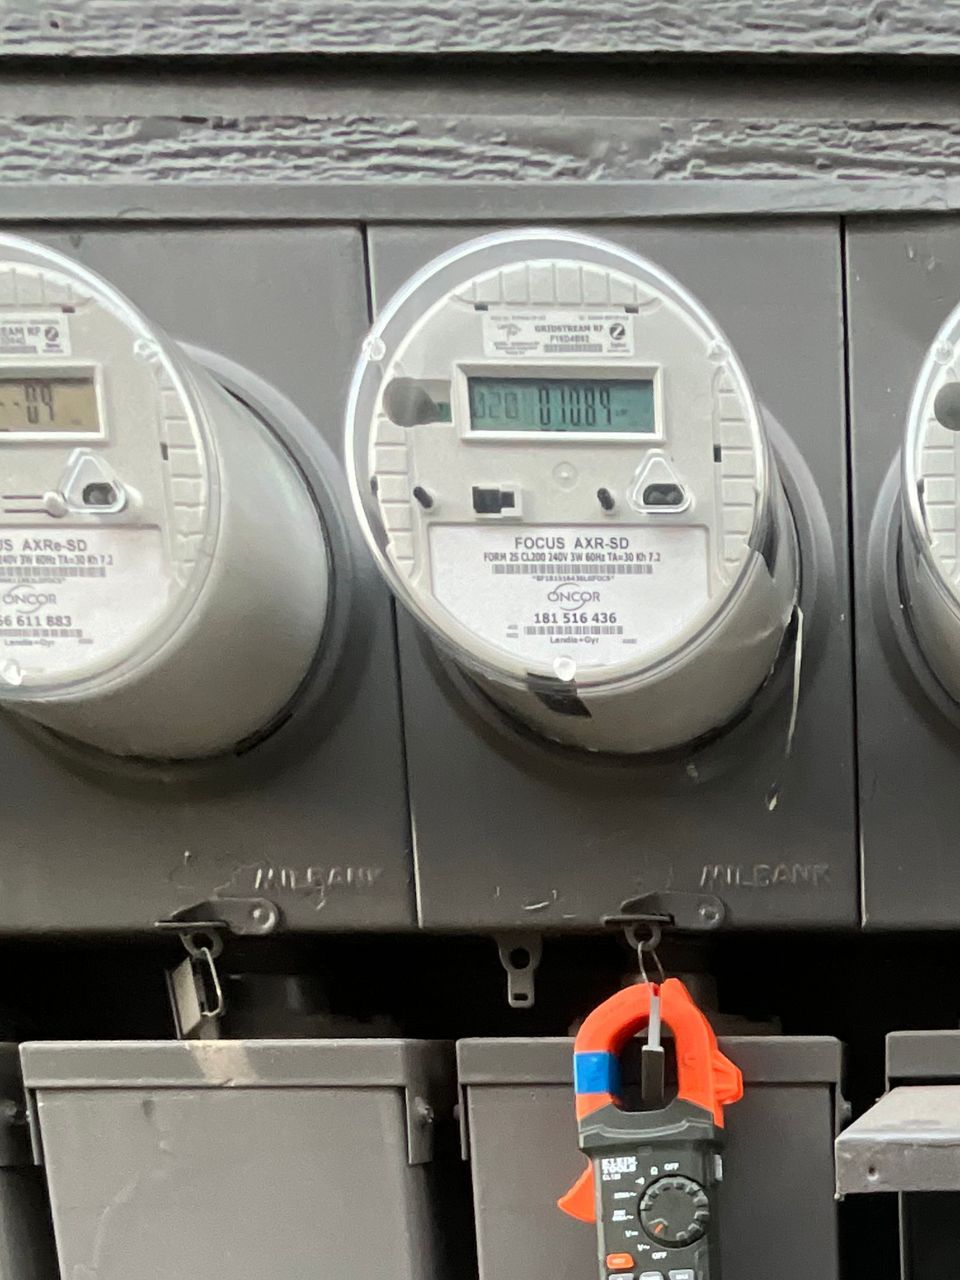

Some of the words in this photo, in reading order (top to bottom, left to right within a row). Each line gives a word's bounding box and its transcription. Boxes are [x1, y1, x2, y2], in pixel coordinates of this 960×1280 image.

[514, 537, 565, 549] FOCUS
[574, 537, 629, 549] AXR-SD
[484, 552, 507, 562] FORM
[521, 552, 546, 562] CL200
[548, 552, 568, 562] 240V
[2, 593, 57, 605] ONCOR
[547, 591, 600, 602] ONCOR
[534, 613, 557, 624] 181
[563, 613, 588, 624] 516
[592, 613, 617, 623] 436
